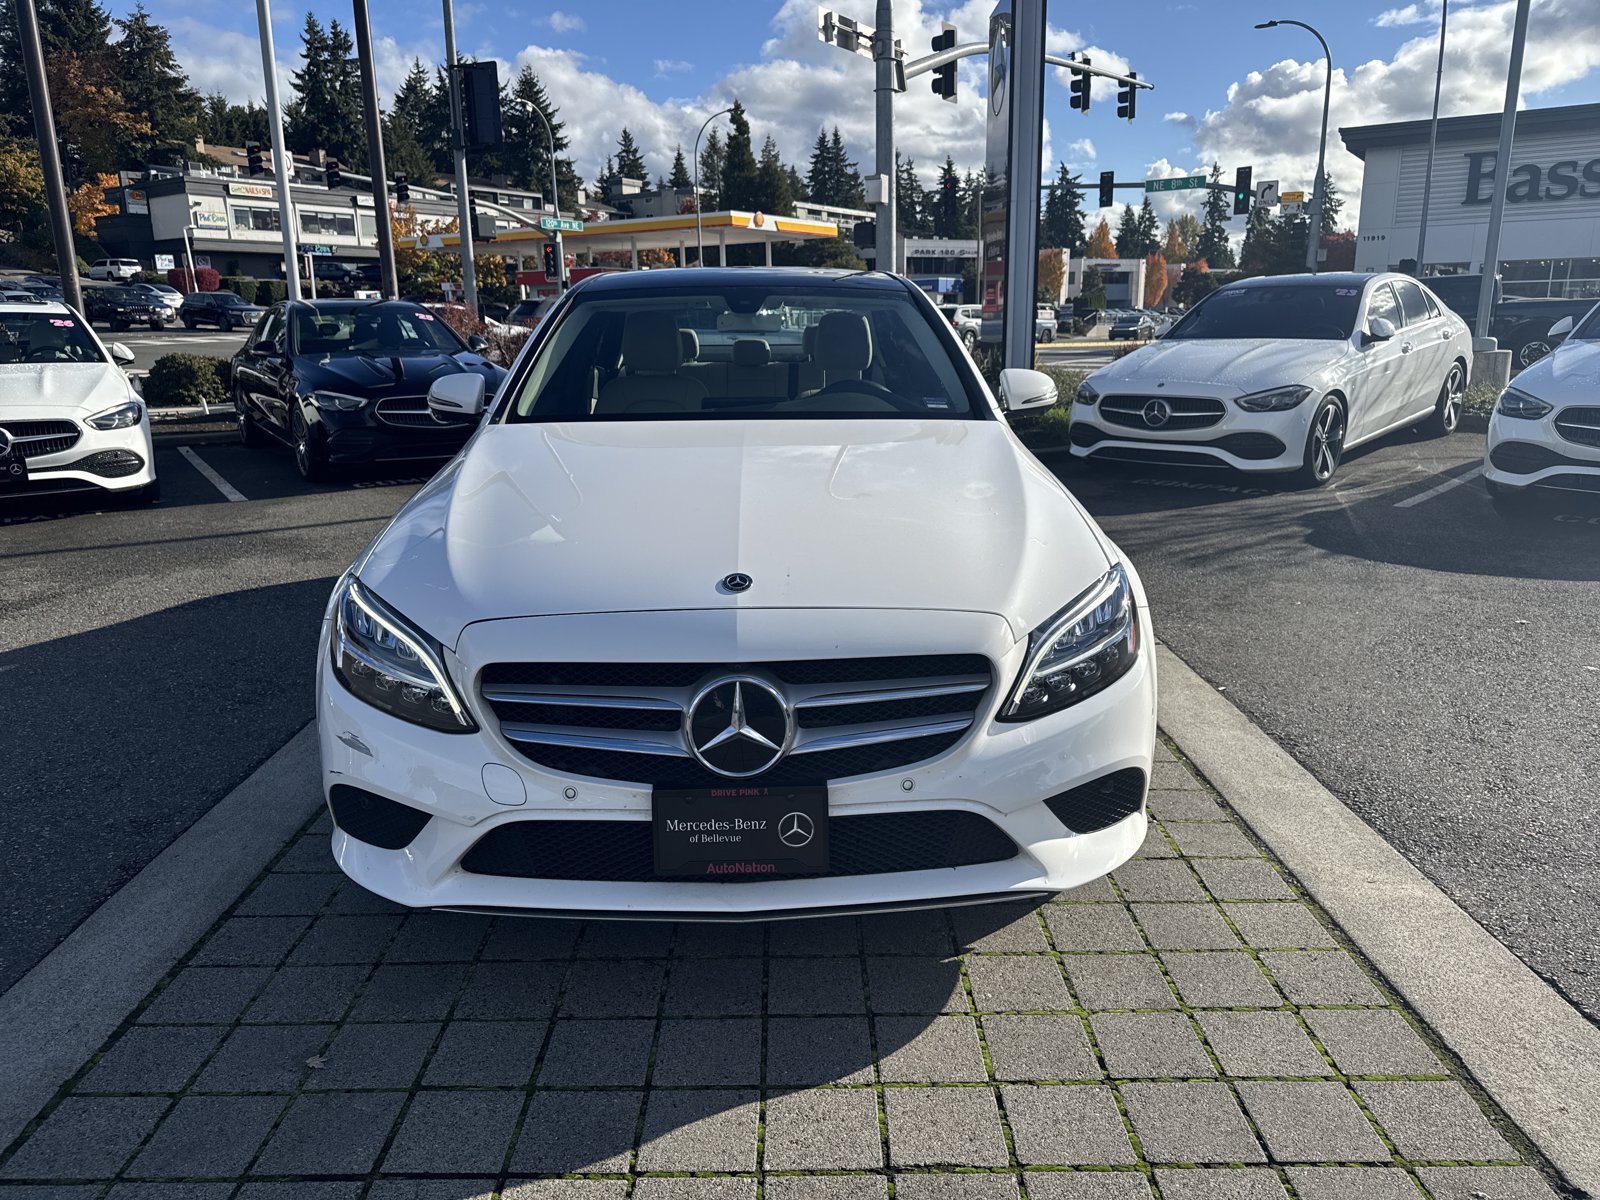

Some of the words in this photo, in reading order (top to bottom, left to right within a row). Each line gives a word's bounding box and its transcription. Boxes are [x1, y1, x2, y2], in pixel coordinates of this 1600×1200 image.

[1152, 180, 1164, 191] NE
[1170, 179, 1183, 190] 8th
[1188, 178, 1198, 188] St
[545, 219, 558, 228] 120th
[560, 221, 570, 229] Ave
[571, 222, 579, 230] NE
[711, 789, 737, 797] DRIVE
[739, 788, 760, 797] PINK
[666, 818, 767, 832] Mercedes-Benz
[689, 834, 699, 843] of
[701, 833, 742, 843] Bellevue
[706, 862, 776, 874] AutoNation
